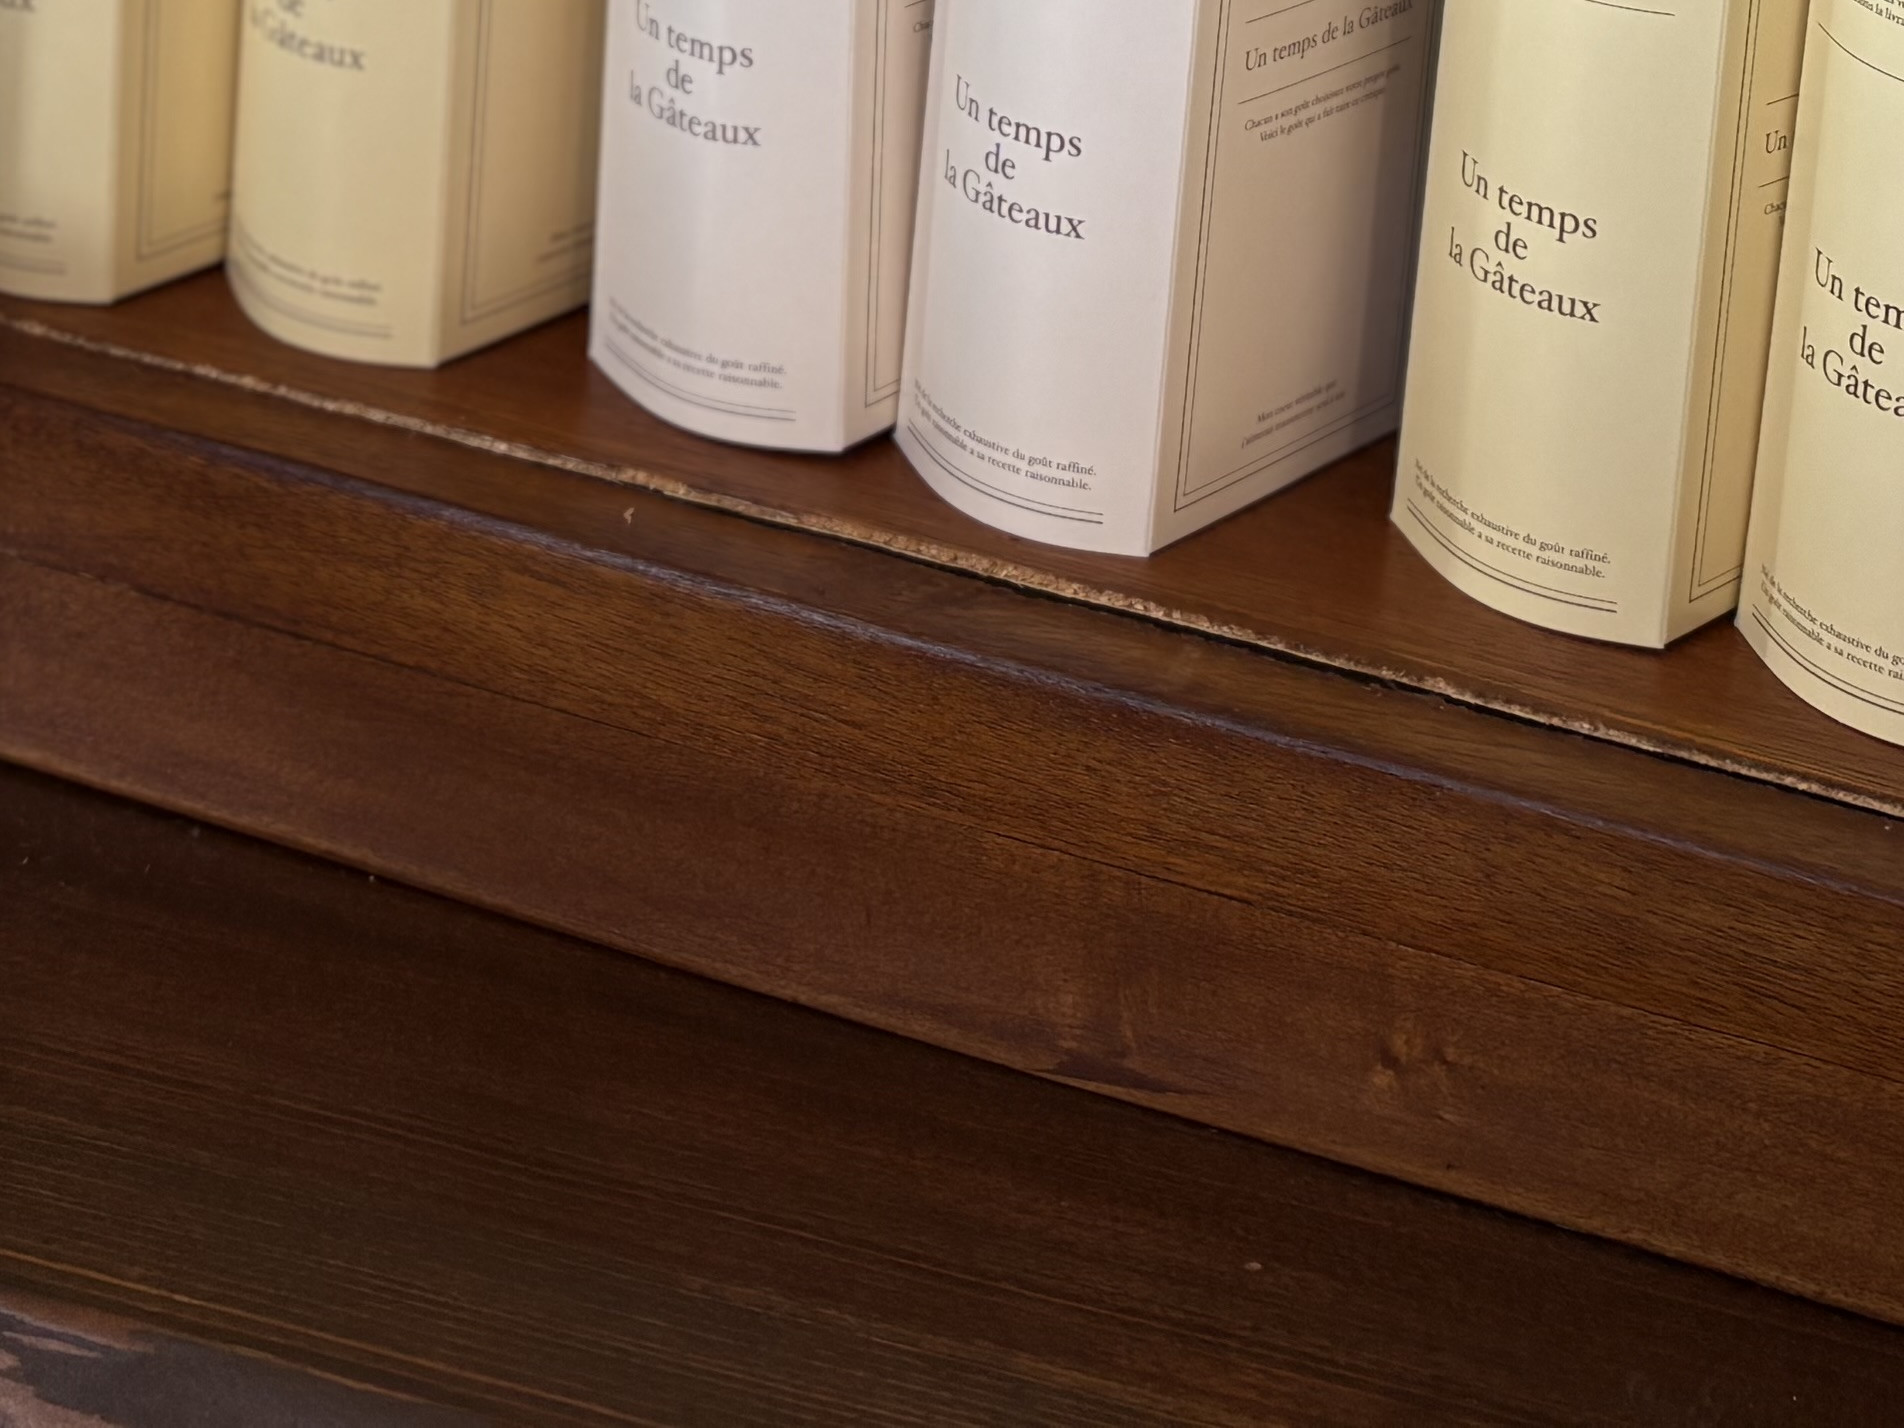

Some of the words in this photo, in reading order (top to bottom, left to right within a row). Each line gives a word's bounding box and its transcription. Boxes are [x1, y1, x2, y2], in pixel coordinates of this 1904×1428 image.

[1245, 46, 1267, 72] Un
[1272, 33, 1318, 59] temps
[1322, 21, 1339, 44] de
[1342, 15, 1354, 37] la
[955, 73, 980, 122] Un
[987, 106, 1083, 162] temps
[984, 142, 1016, 180] de
[944, 148, 957, 189] la
[963, 168, 1086, 240] Gâteaux
[1461, 149, 1489, 201] Un
[1497, 184, 1598, 244] temps
[1494, 221, 1528, 260] de
[1448, 225, 1463, 267] la
[1470, 247, 1601, 324] Gâteaux
[1815, 247, 1844, 302] Un
[1800, 325, 1815, 370] la
[1848, 324, 1885, 365] de
